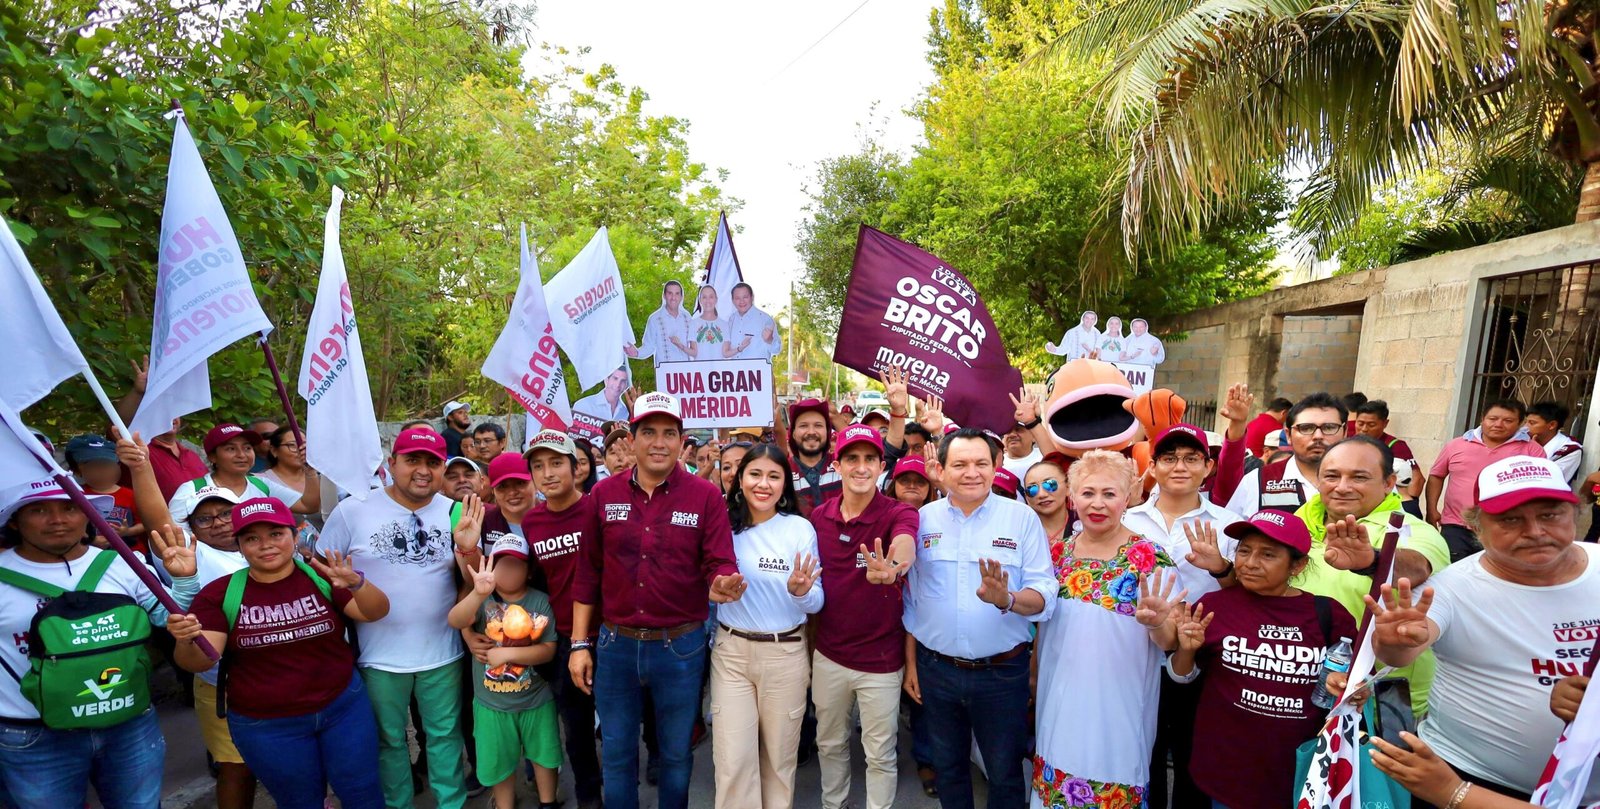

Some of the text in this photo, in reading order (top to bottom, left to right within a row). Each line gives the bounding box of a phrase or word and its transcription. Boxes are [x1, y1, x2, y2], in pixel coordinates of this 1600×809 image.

[934, 269, 975, 306] VOTA
[896, 276, 987, 345] OSCAR
[883, 297, 980, 360] BRITO
[891, 325, 961, 361] DIPUTADO FEDERAL
[909, 339, 928, 352] DTTO
[876, 346, 951, 388] morena
[666, 370, 762, 395] UNA GRAN
[909, 374, 918, 382] de
[919, 378, 944, 394] México
[681, 394, 752, 419] MÉRIDA
[846, 427, 873, 439] ROMMEL
[1496, 466, 1549, 478] CLAUDIA
[240, 503, 275, 517] ROMMEL
[672, 511, 698, 520] OSCAR
[671, 516, 698, 526] BRITO
[758, 563, 790, 571] ROSALES
[239, 594, 327, 625] ROMMEL
[71, 614, 116, 630] La 4T
[91, 623, 120, 635] pinta
[1561, 621, 1577, 629] DE
[72, 630, 129, 645] de Verde
[240, 635, 262, 647] UNA
[263, 631, 294, 644] GRAN
[1260, 630, 1301, 640] VOTA
[1222, 650, 1323, 677] SHEINBAU
[71, 694, 135, 718] VERDE
[1242, 688, 1303, 709] morena
[1248, 701, 1275, 711] esperanza
